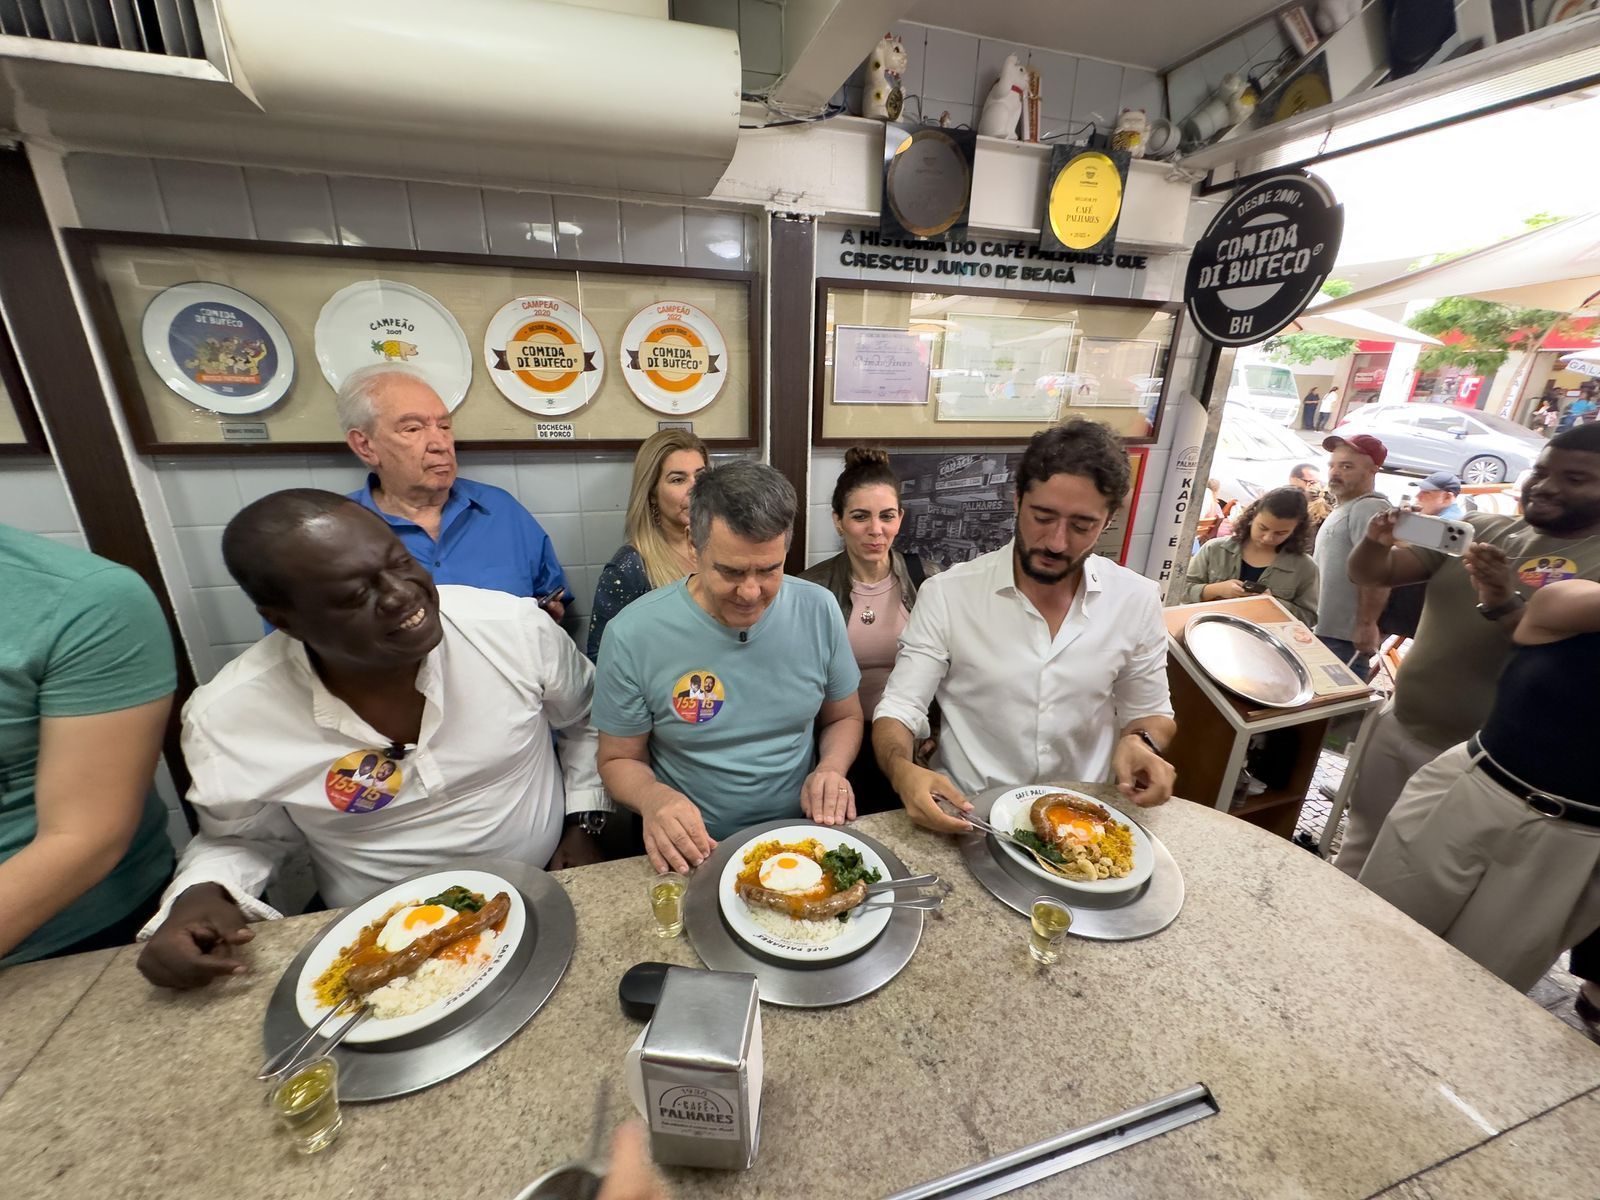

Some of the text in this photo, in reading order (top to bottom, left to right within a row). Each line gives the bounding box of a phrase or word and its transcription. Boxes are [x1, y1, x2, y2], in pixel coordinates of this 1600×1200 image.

[1237, 188, 1300, 218] DESDE 2000
[1216, 223, 1298, 262] COMIDA
[841, 229, 855, 245] A
[951, 240, 977, 255] DO
[980, 240, 1025, 259] CAFÉ
[1115, 254, 1148, 270] QUE
[840, 250, 1076, 284] CRESCEU JUNTO DE BEAGÁ
[1198, 264, 1224, 288] DI
[522, 300, 559, 311] CAMPEÃO
[657, 306, 691, 316] CAMPEÃO
[534, 309, 551, 317] 2020
[667, 313, 682, 321] 2022
[369, 317, 415, 332] CAMPEÃO
[1228, 315, 1254, 335] BH
[522, 346, 565, 357] COMIDA
[653, 347, 692, 359] COMIDA
[517, 357, 531, 368] DI
[647, 357, 659, 368] DI
[961, 500, 1003, 511] PALHARES
[1174, 478, 1193, 524] KAOL
[1168, 534, 1178, 547] É
[361, 786, 381, 802] 15
[683, 1100, 710, 1112] CAFÉ
[660, 1106, 734, 1125] PALHARES
